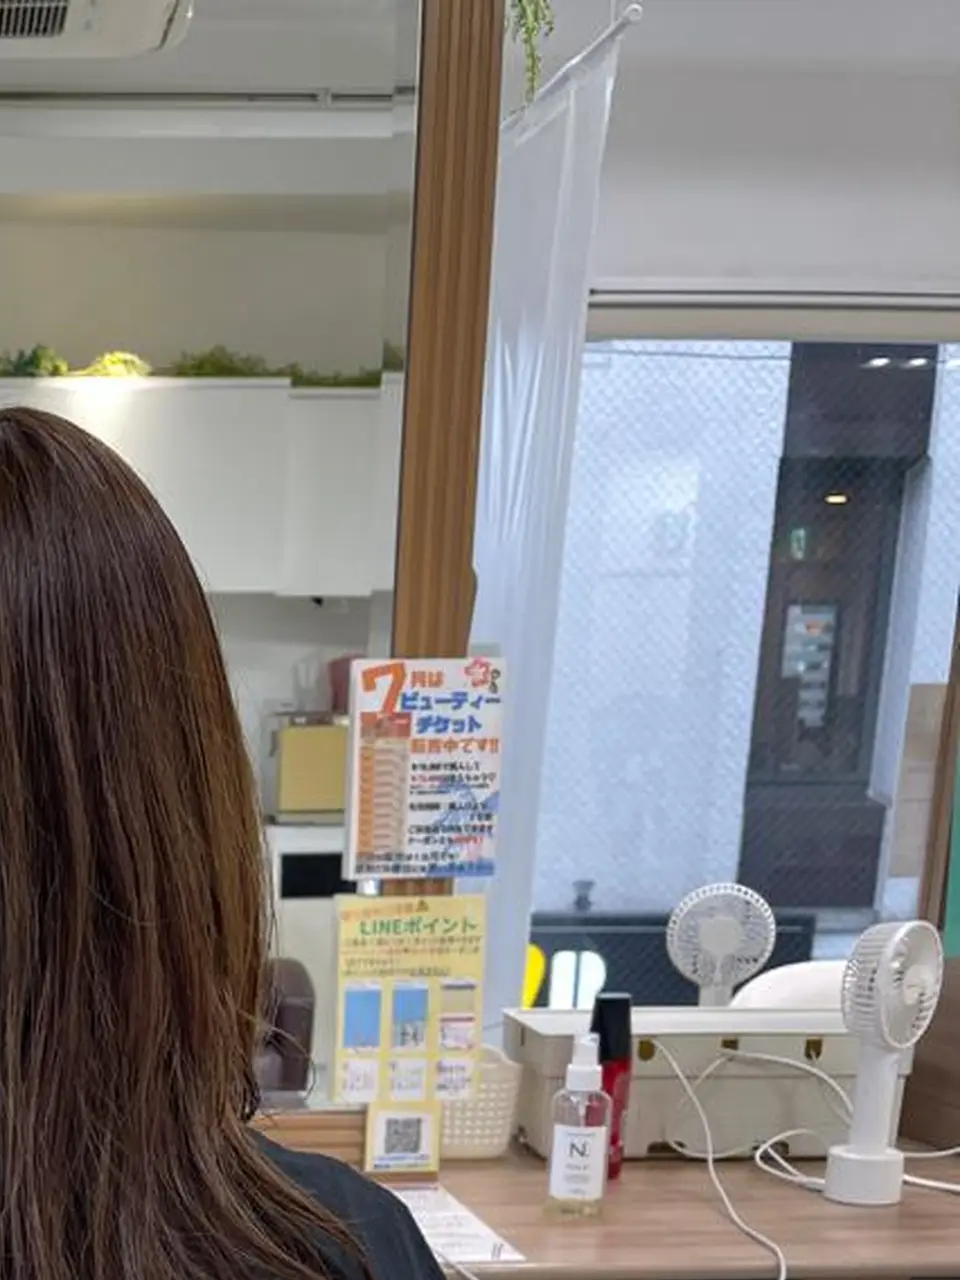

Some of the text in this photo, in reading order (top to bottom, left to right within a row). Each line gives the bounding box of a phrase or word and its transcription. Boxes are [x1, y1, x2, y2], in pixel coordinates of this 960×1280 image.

[401, 691, 501, 710] ビューティー
[416, 715, 482, 733] チケット
[359, 916, 477, 935] LINEポイント
